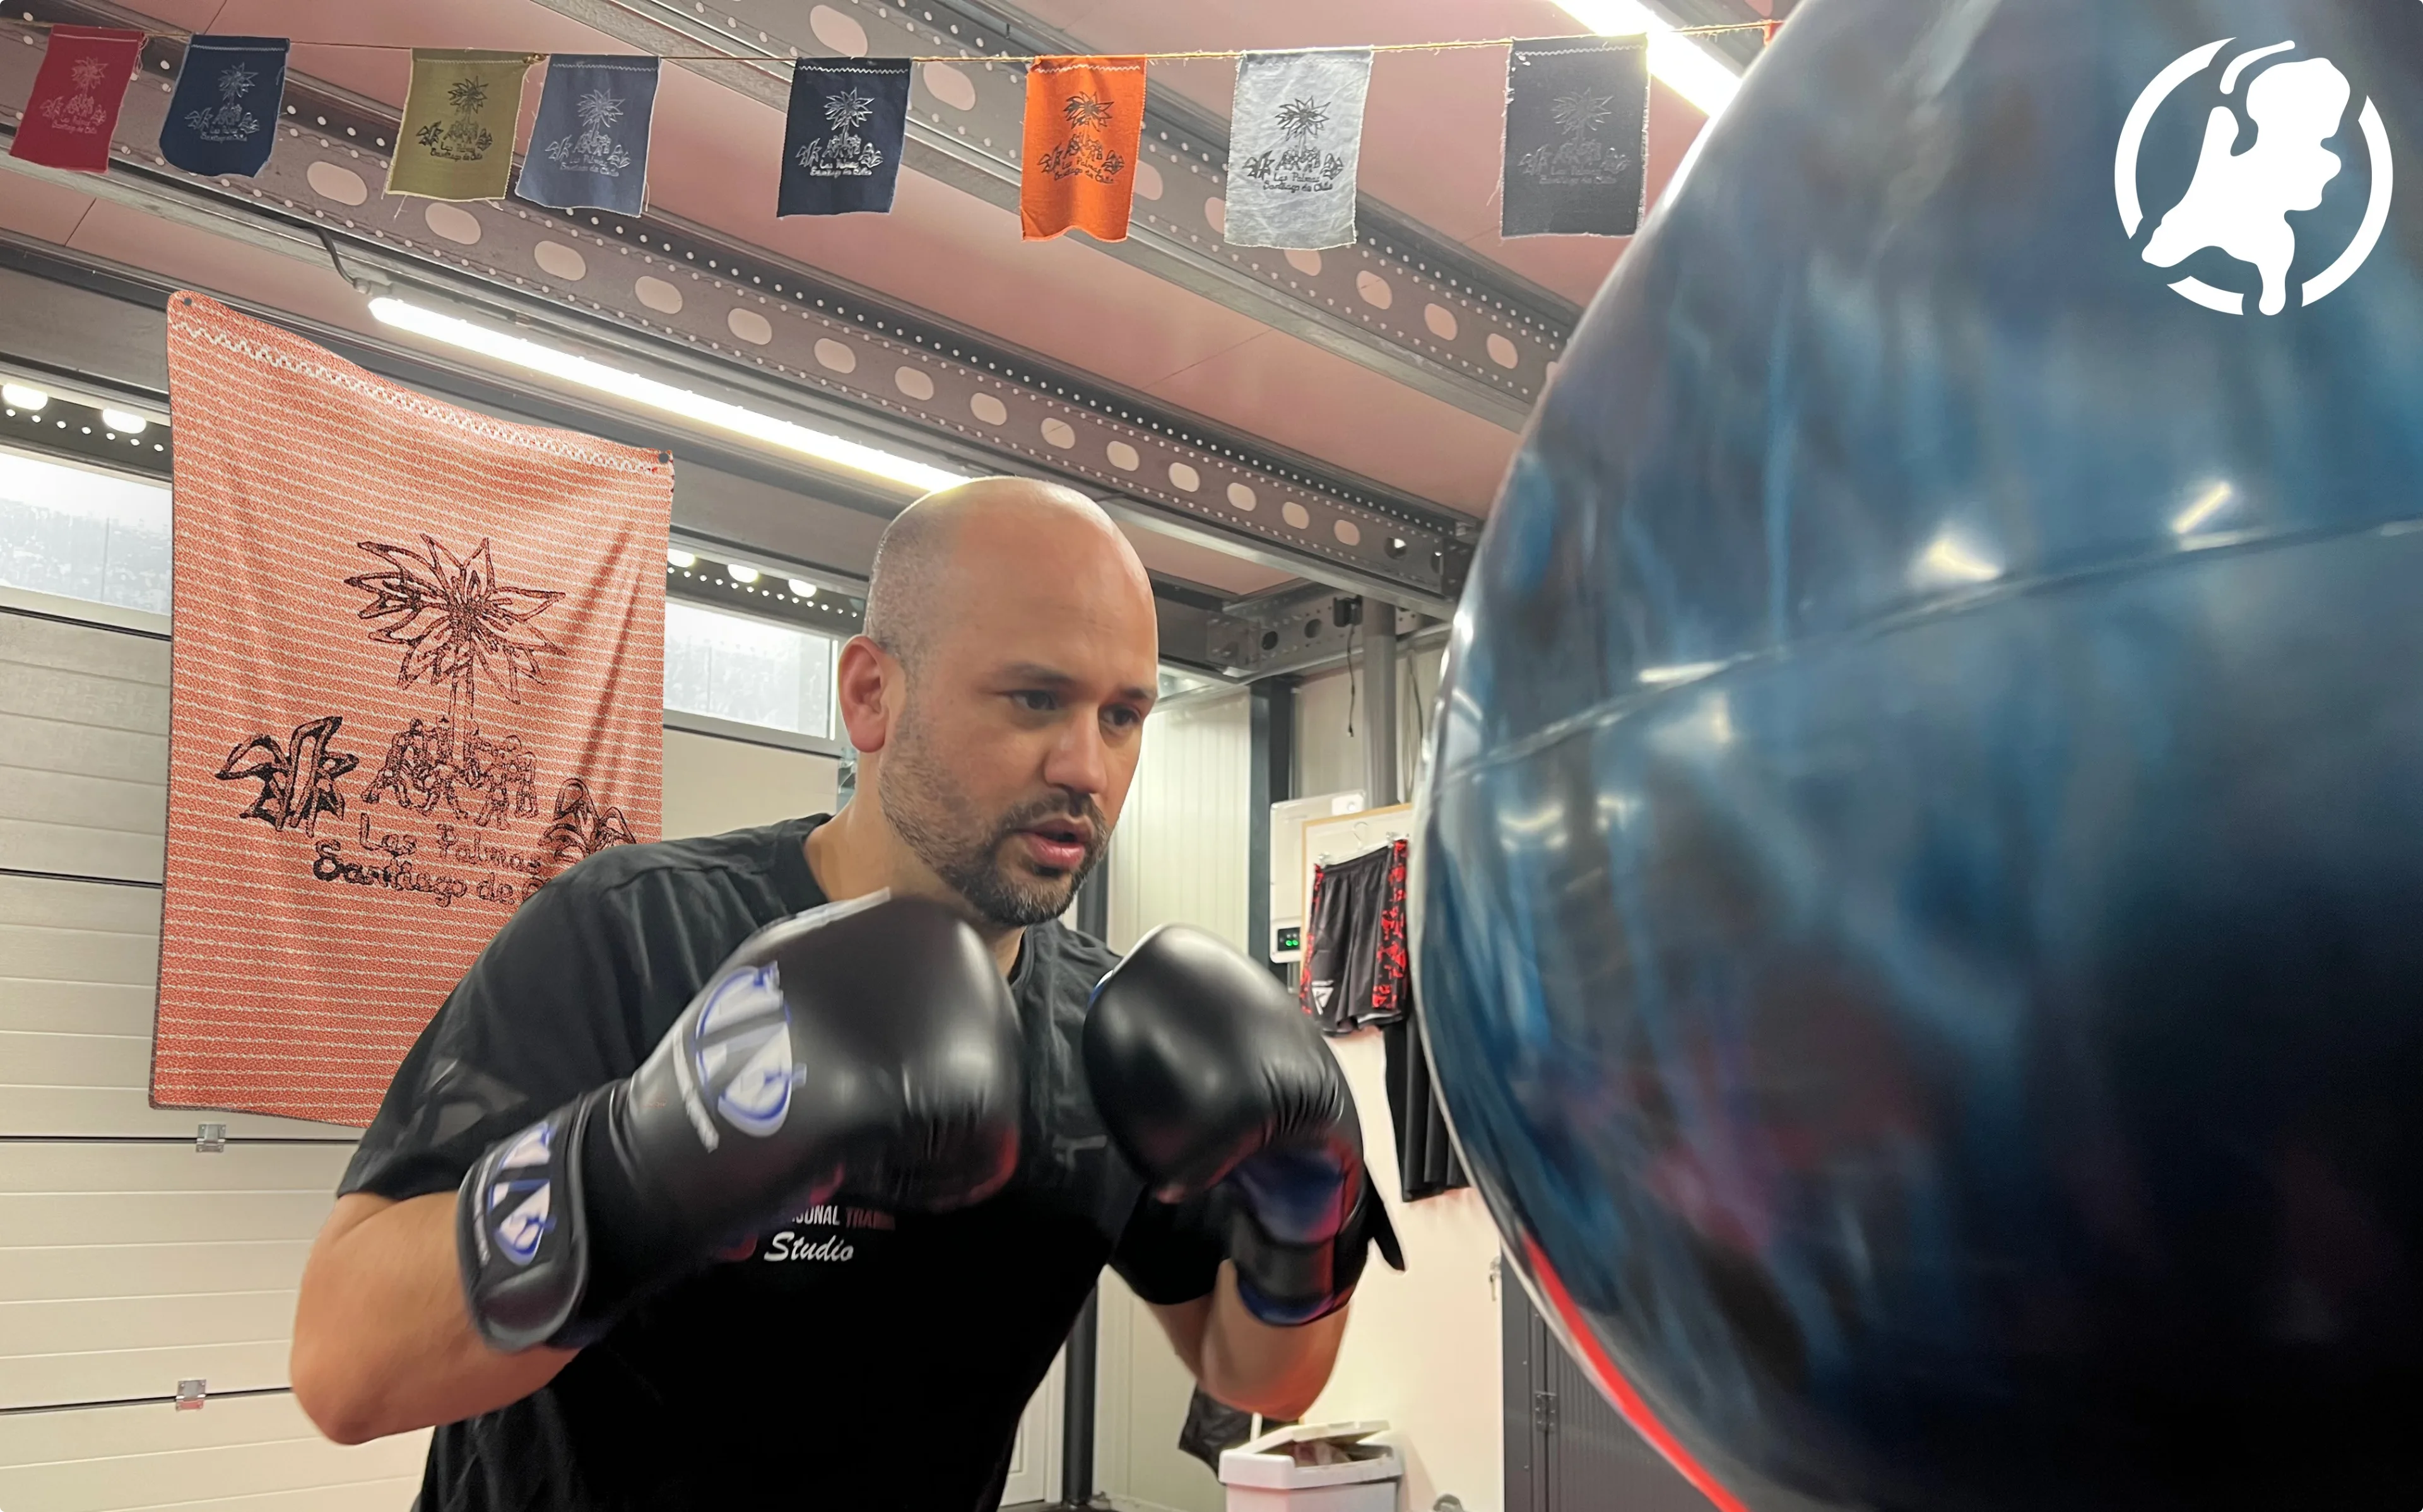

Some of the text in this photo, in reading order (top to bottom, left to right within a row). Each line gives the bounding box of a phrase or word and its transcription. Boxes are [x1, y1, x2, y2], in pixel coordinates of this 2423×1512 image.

[360, 812, 543, 876] Las Palmas
[763, 1231, 854, 1262] Studio
